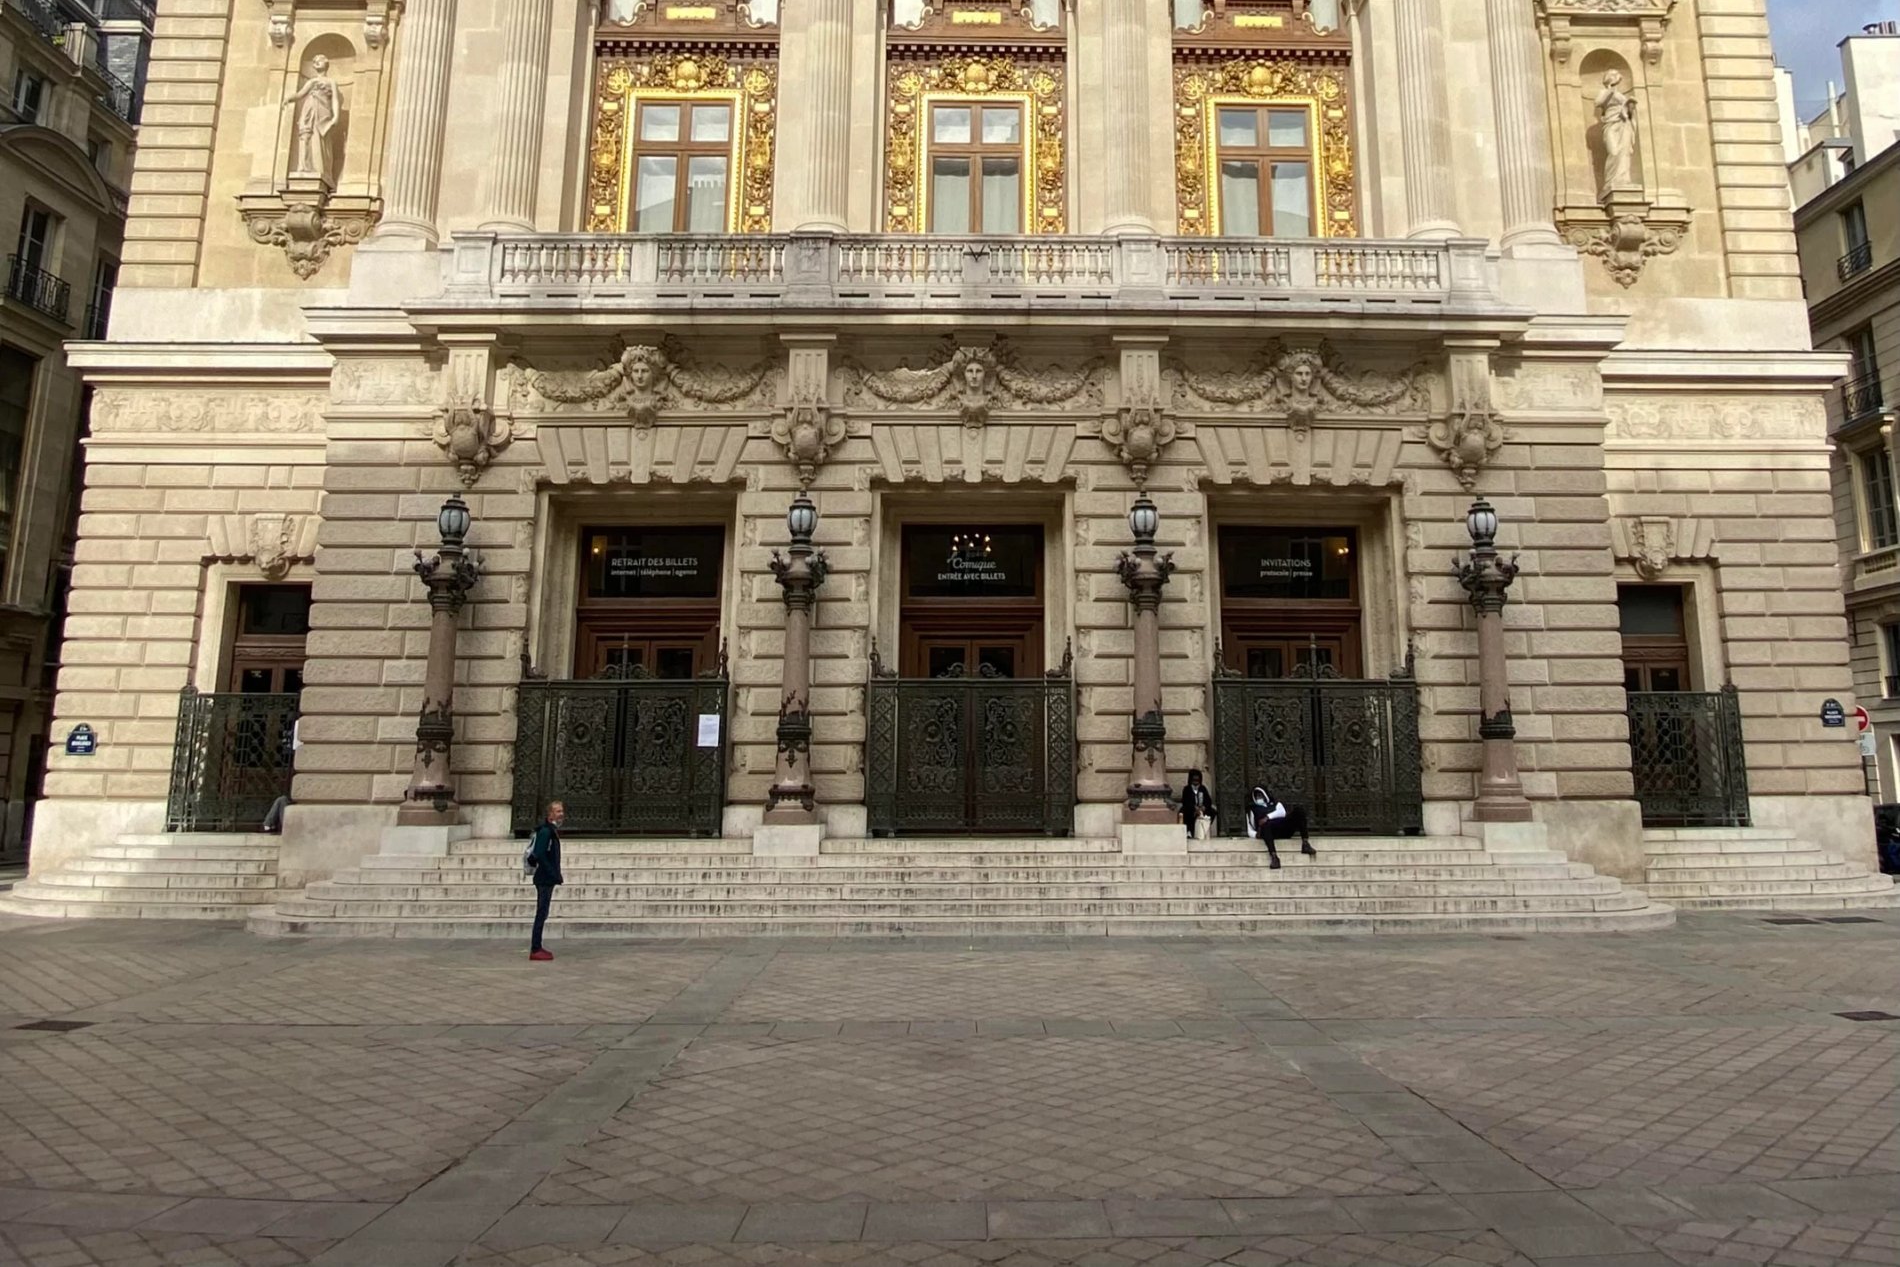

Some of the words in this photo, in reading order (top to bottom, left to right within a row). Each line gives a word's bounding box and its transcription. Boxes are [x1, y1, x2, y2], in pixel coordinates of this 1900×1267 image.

[611, 558, 646, 566] RETRAIT
[648, 558, 664, 566] DES
[665, 558, 698, 566] BILLETS
[948, 554, 997, 571] Comique
[1261, 558, 1312, 567] INVITATIONS
[611, 568, 636, 576] internet
[640, 568, 672, 578] téléphone
[675, 569, 698, 577] agence
[938, 572, 962, 580] ENTRÉE
[963, 572, 980, 580] AVEC
[980, 572, 1006, 580] BILLETS
